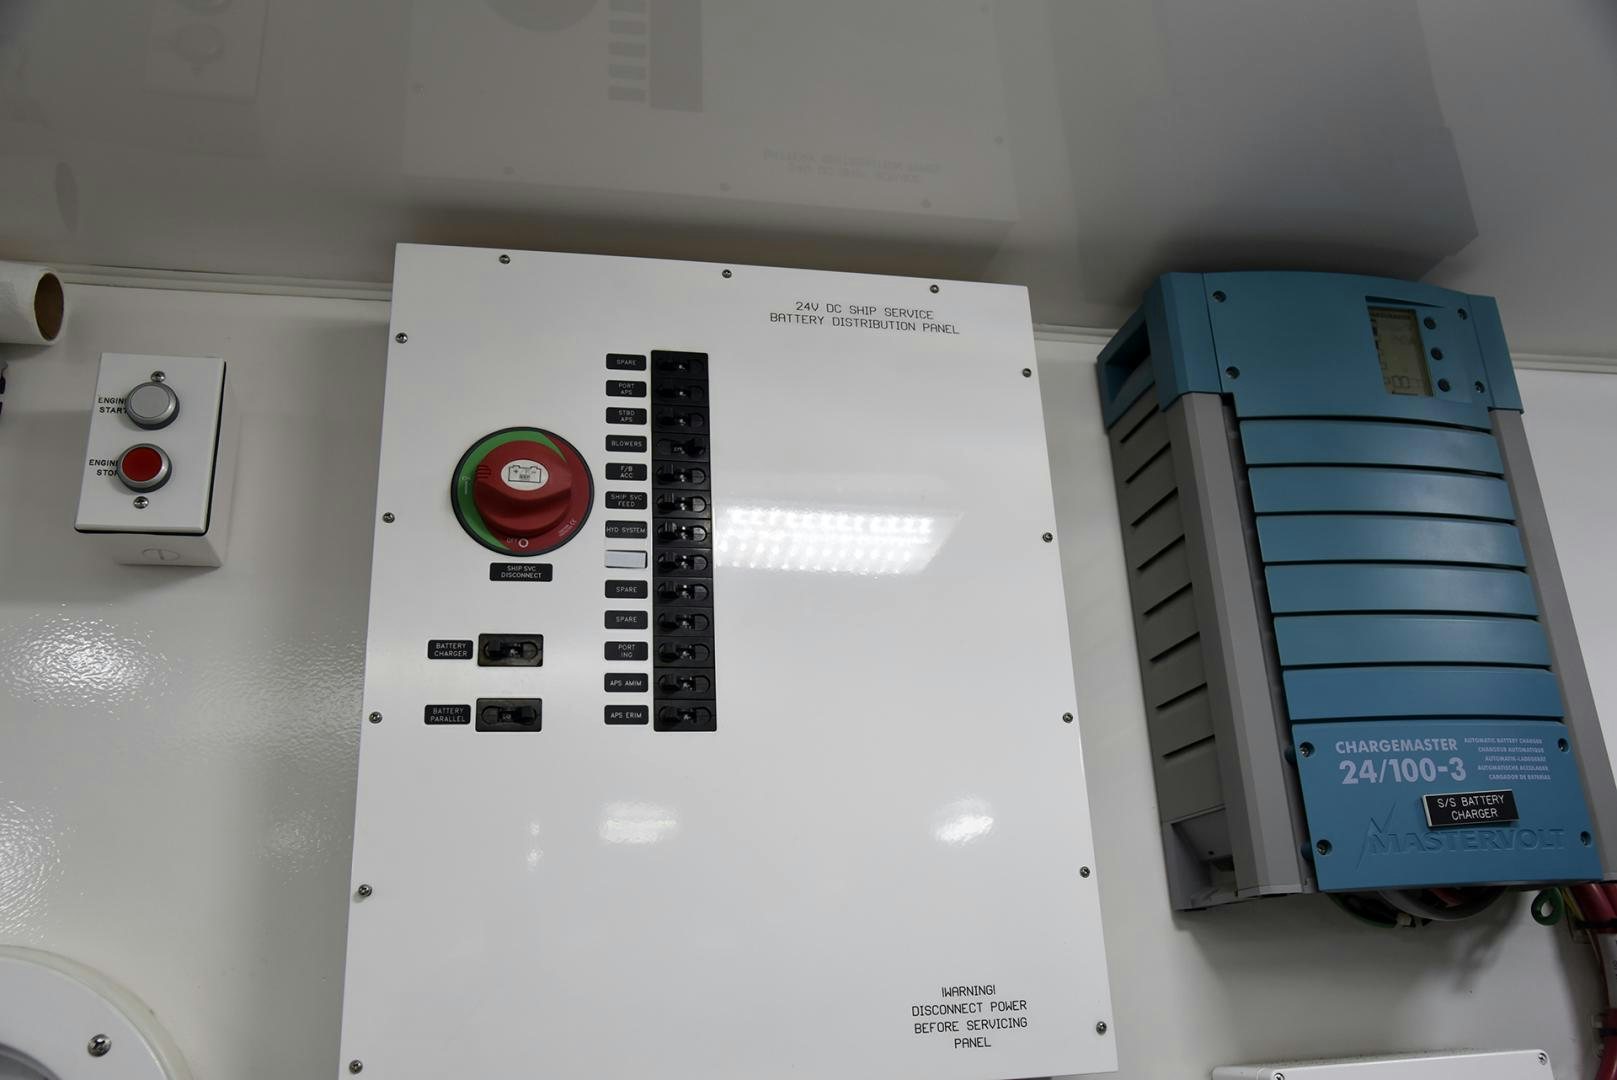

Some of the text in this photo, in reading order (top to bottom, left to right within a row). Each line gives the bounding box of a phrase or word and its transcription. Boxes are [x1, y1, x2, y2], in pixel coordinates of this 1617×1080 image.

[796, 301, 934, 320] 24V DC SHIP SERVICE
[769, 312, 960, 335] BATTERY DISTRIBUTION PANEL
[97, 397, 127, 405] ENGIN
[88, 458, 119, 467] ENGIN
[500, 571, 542, 579] DISCONNECT
[430, 715, 466, 723] PARALLEL
[1335, 737, 1458, 754] CHARGEMASTER
[1339, 756, 1467, 785] 24/100-3
[1436, 794, 1505, 809] S/S BATTERY
[1450, 808, 1499, 821] CHARGER
[1365, 828, 1565, 857] MASTERVOLT
[911, 999, 1028, 1017] DISCONNECT POWER
[914, 1016, 1028, 1034] BEFORE SERVICING
[954, 1036, 992, 1049] PANEL
